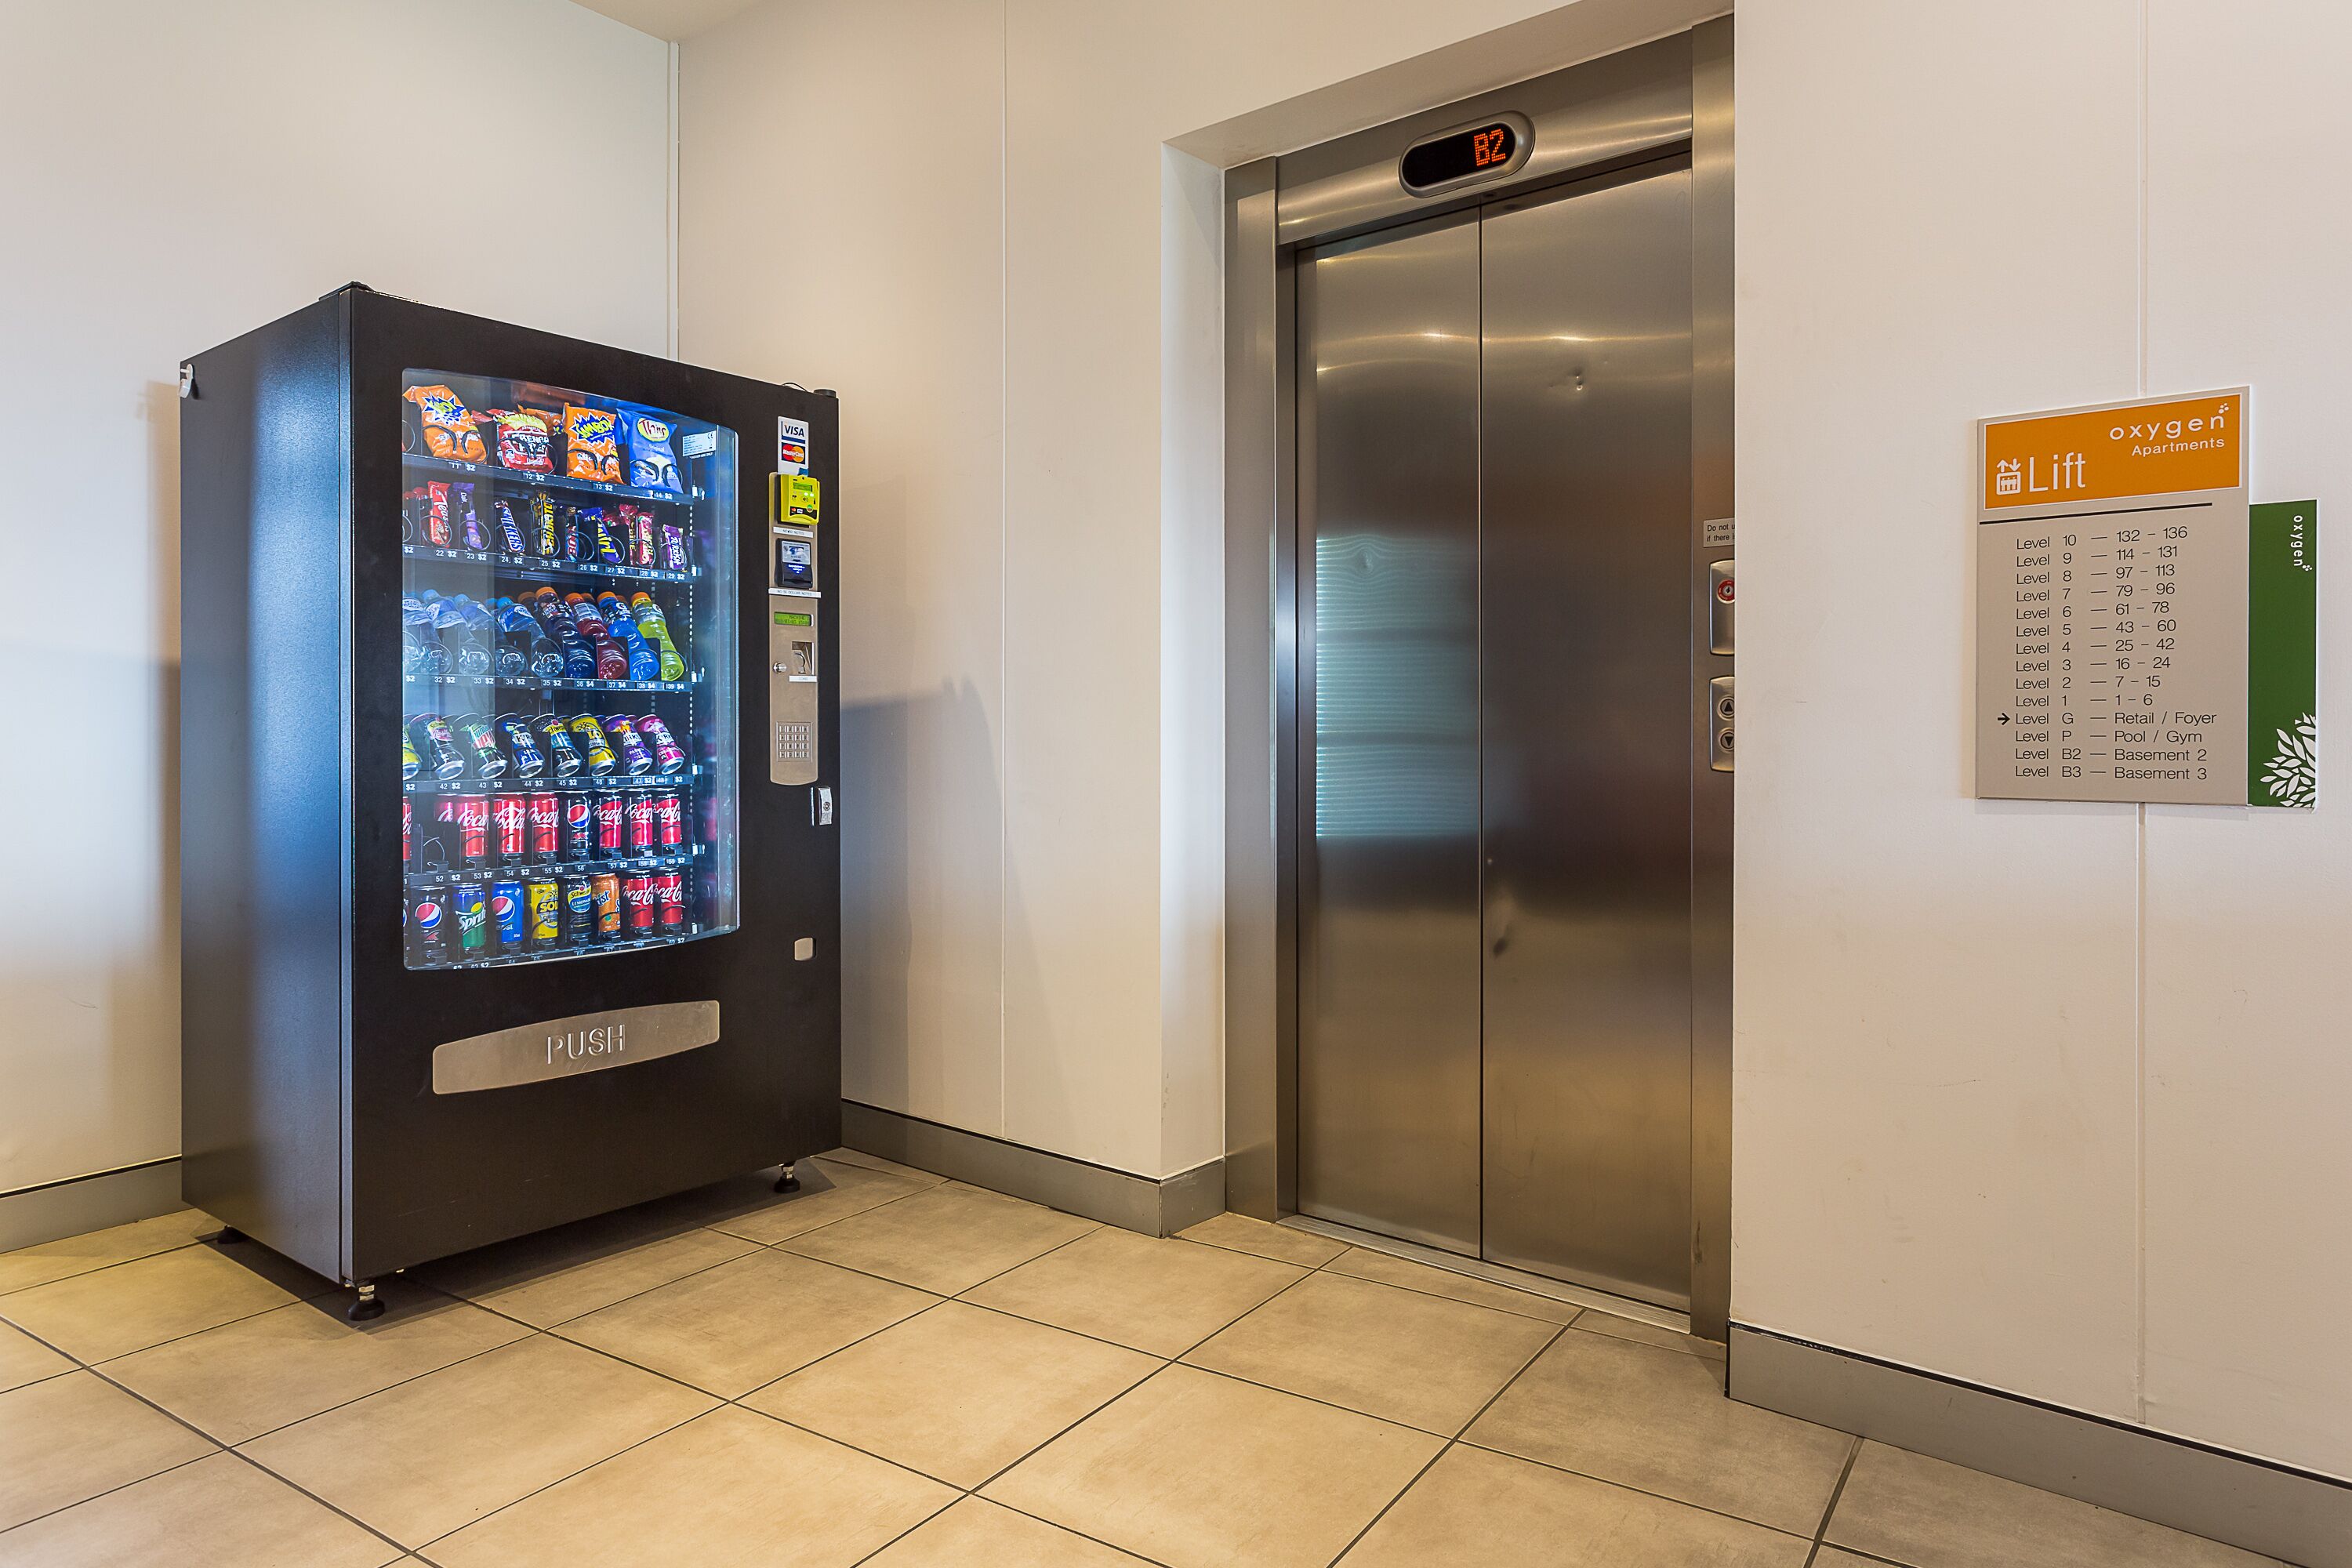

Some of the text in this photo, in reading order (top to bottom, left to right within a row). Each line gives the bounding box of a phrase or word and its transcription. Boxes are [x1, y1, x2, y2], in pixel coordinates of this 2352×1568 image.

[1474, 129, 1506, 166] B2
[784, 424, 804, 437] VISA
[2109, 412, 2224, 441] oxygen
[2131, 437, 2225, 457] Apartments
[2029, 452, 2086, 492] Lift
[2016, 525, 2188, 550] Level 10 132 136
[2290, 514, 2303, 567] oxygen
[2016, 545, 2177, 568] Level 9 114 131
[2016, 564, 2175, 585] Level 8 97 113
[2016, 582, 2176, 602] Level 7 79 96
[2016, 601, 2169, 620] Level 6 61 78
[2016, 619, 2176, 637] Level 5 43 60
[2016, 637, 2175, 655] Level 4 25 42
[2016, 656, 2171, 672] Level 3 16 24
[2016, 675, 2161, 690] Level 2 7 15
[2016, 693, 2153, 707] Level 1 1 6
[2016, 711, 2217, 727] Level G Retail Foyer
[2016, 730, 2202, 746] Level P Pool Gym
[2016, 748, 2207, 761] Level B2 Basement 2
[2015, 765, 2207, 780] Level B3 Basement 3
[546, 1024, 626, 1065] PUSH
